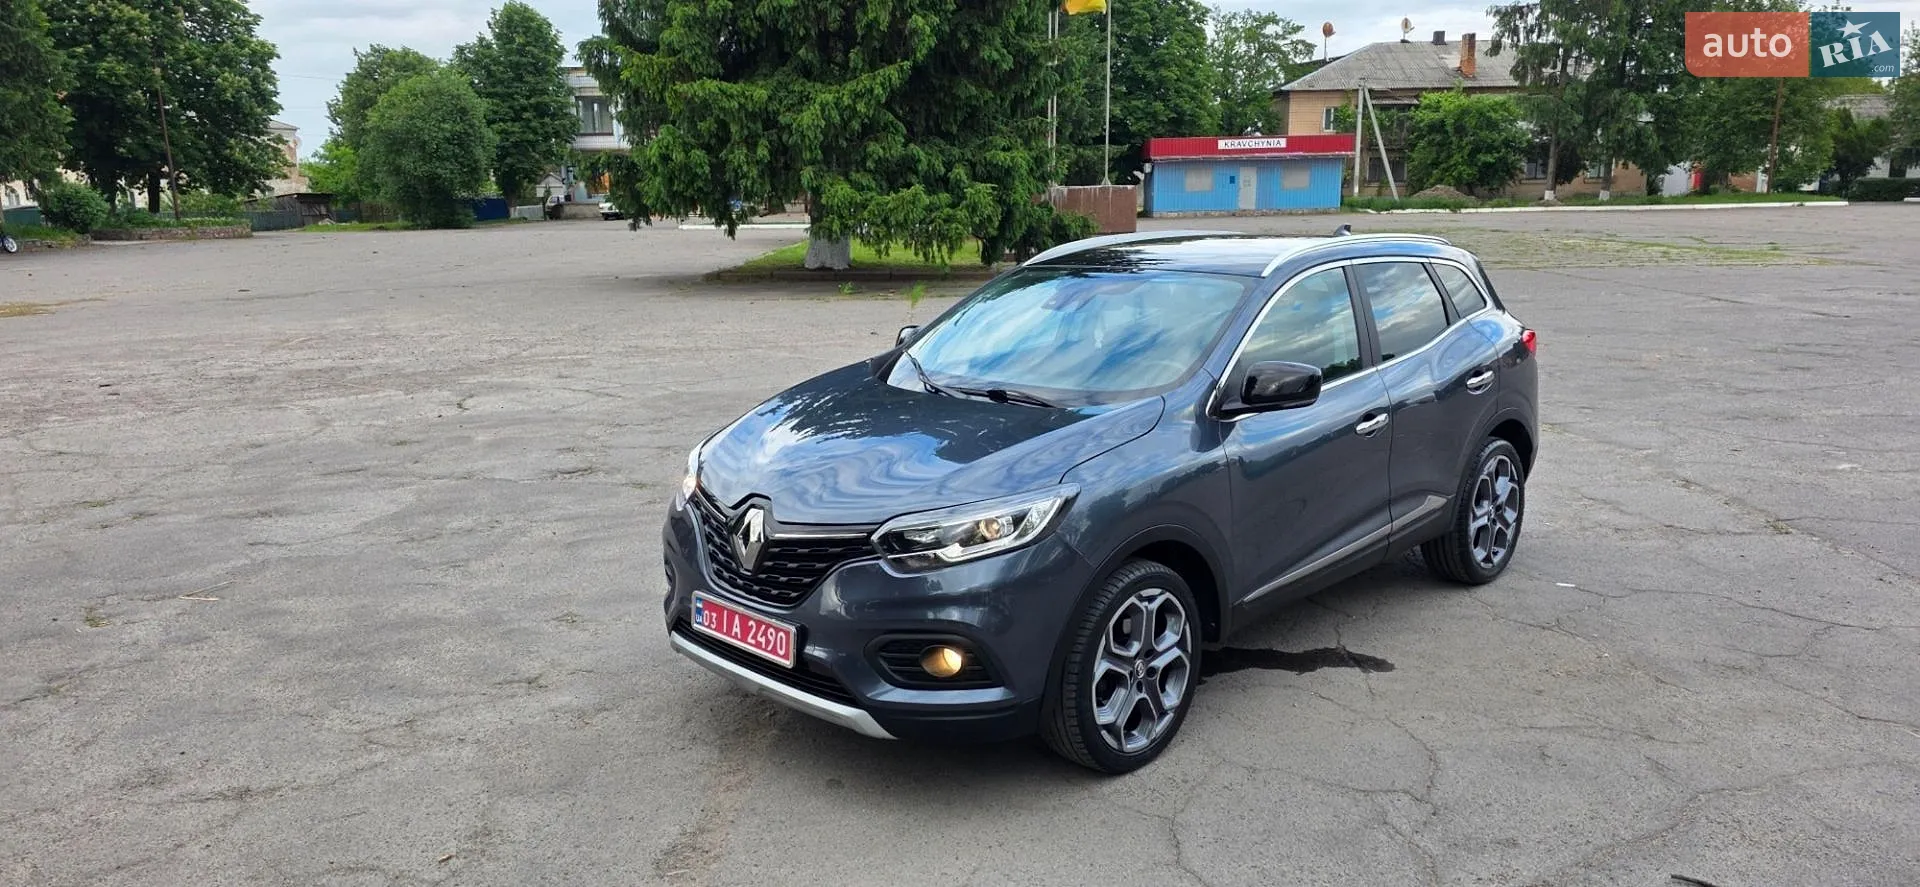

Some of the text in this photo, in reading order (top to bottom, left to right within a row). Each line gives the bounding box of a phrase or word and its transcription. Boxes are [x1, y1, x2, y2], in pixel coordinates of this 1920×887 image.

[1224, 139, 1282, 148] KRAVCHYNIA
[703, 609, 786, 656] 03 IA 2490
